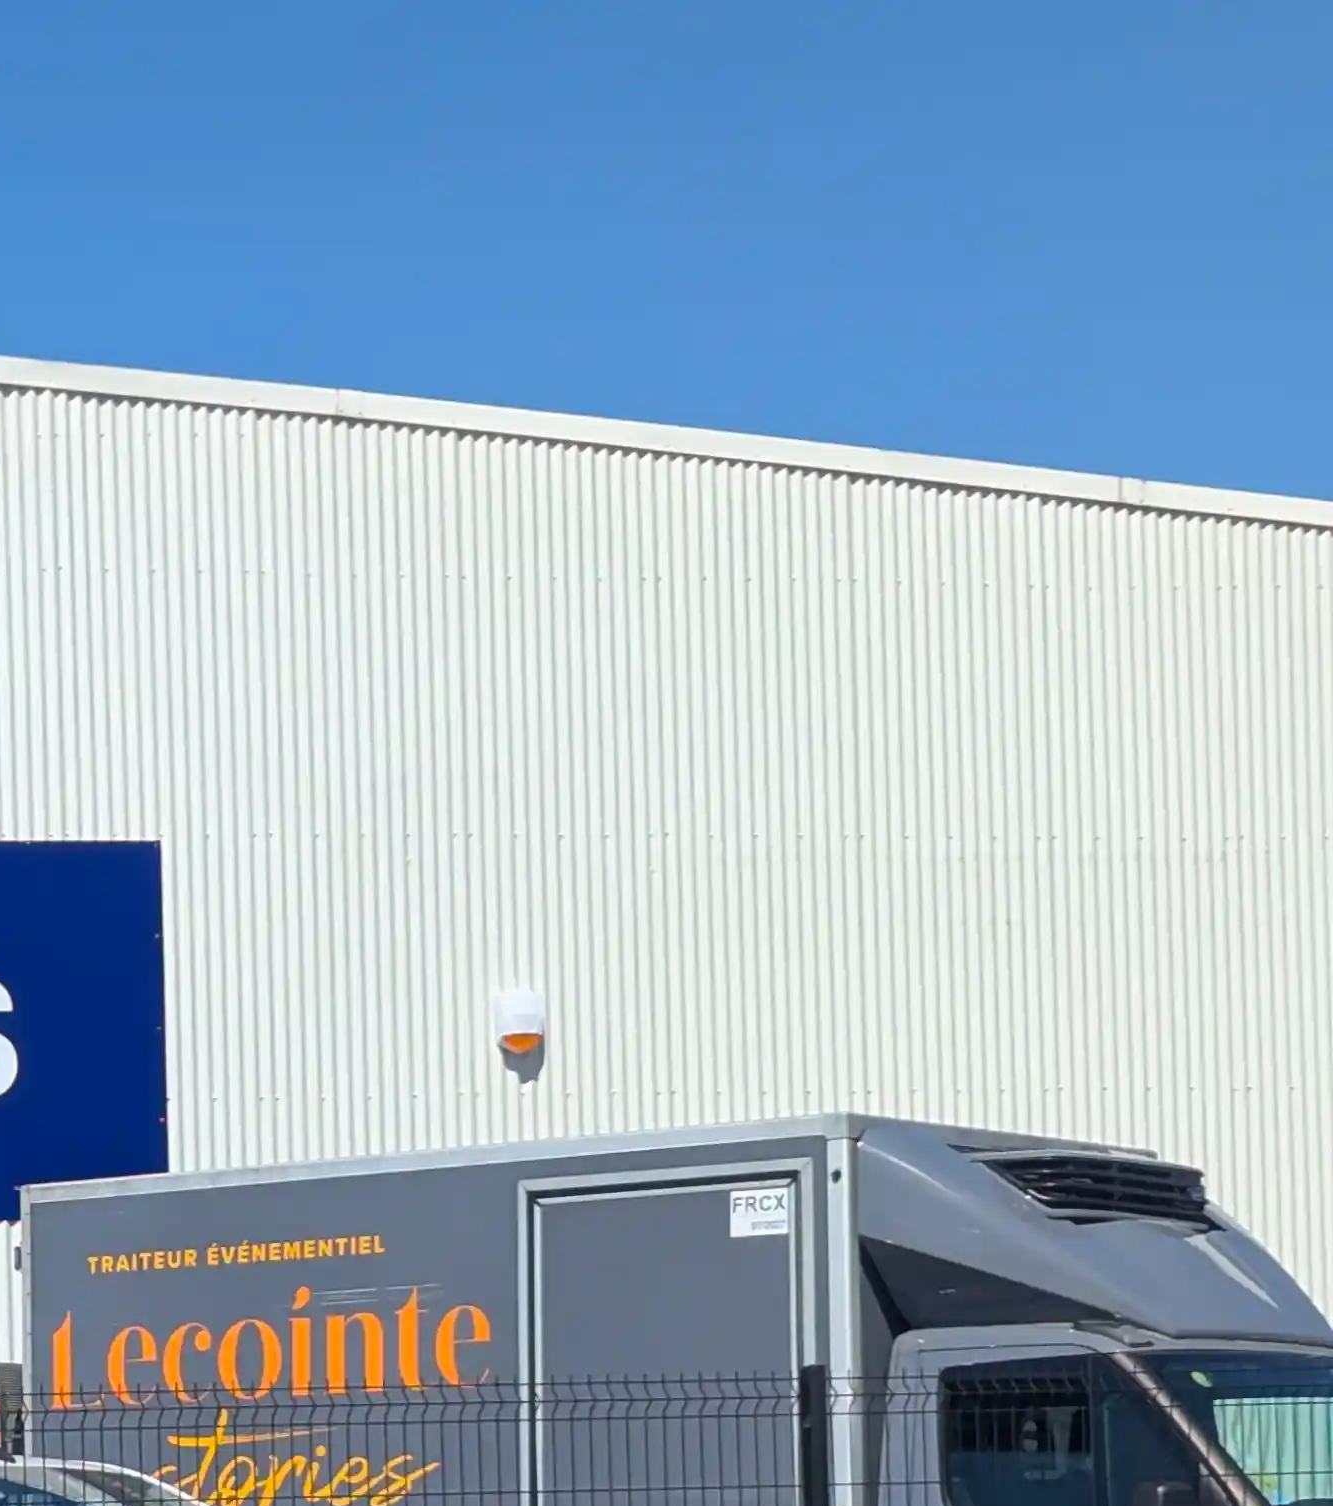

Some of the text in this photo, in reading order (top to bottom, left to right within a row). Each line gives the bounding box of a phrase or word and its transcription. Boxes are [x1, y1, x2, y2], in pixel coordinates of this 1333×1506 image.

[732, 1193, 786, 1214] FRCX
[87, 1234, 386, 1275] TRAITEUR ÉVÉNEMENTIEL
[50, 1285, 491, 1410] Lecointe
